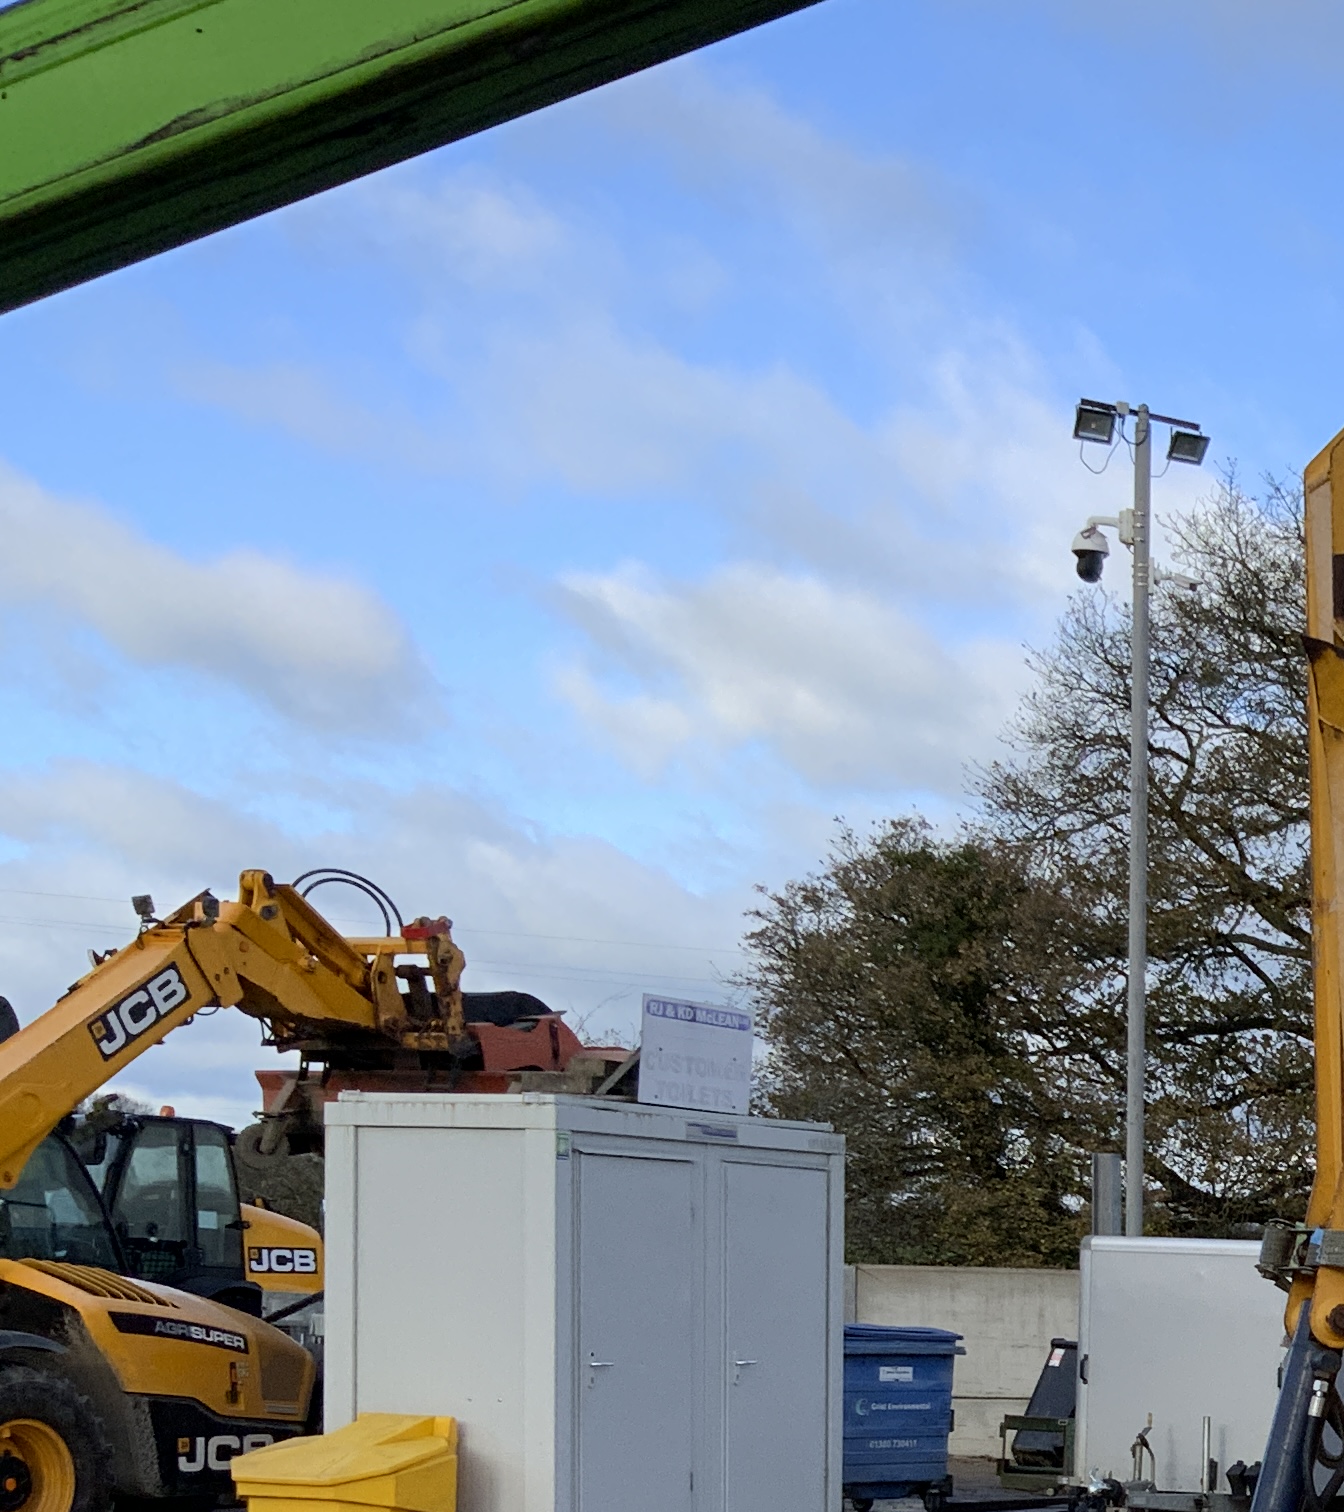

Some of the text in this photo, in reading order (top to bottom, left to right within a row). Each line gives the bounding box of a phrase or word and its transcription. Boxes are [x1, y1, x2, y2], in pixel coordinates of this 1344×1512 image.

[100, 968, 187, 1055] JCB
[649, 1001, 663, 1015] RJ
[665, 1003, 675, 1018] &
[677, 1006, 694, 1020] KD
[695, 1009, 740, 1028] McLEAN
[250, 1249, 316, 1272] JCB
